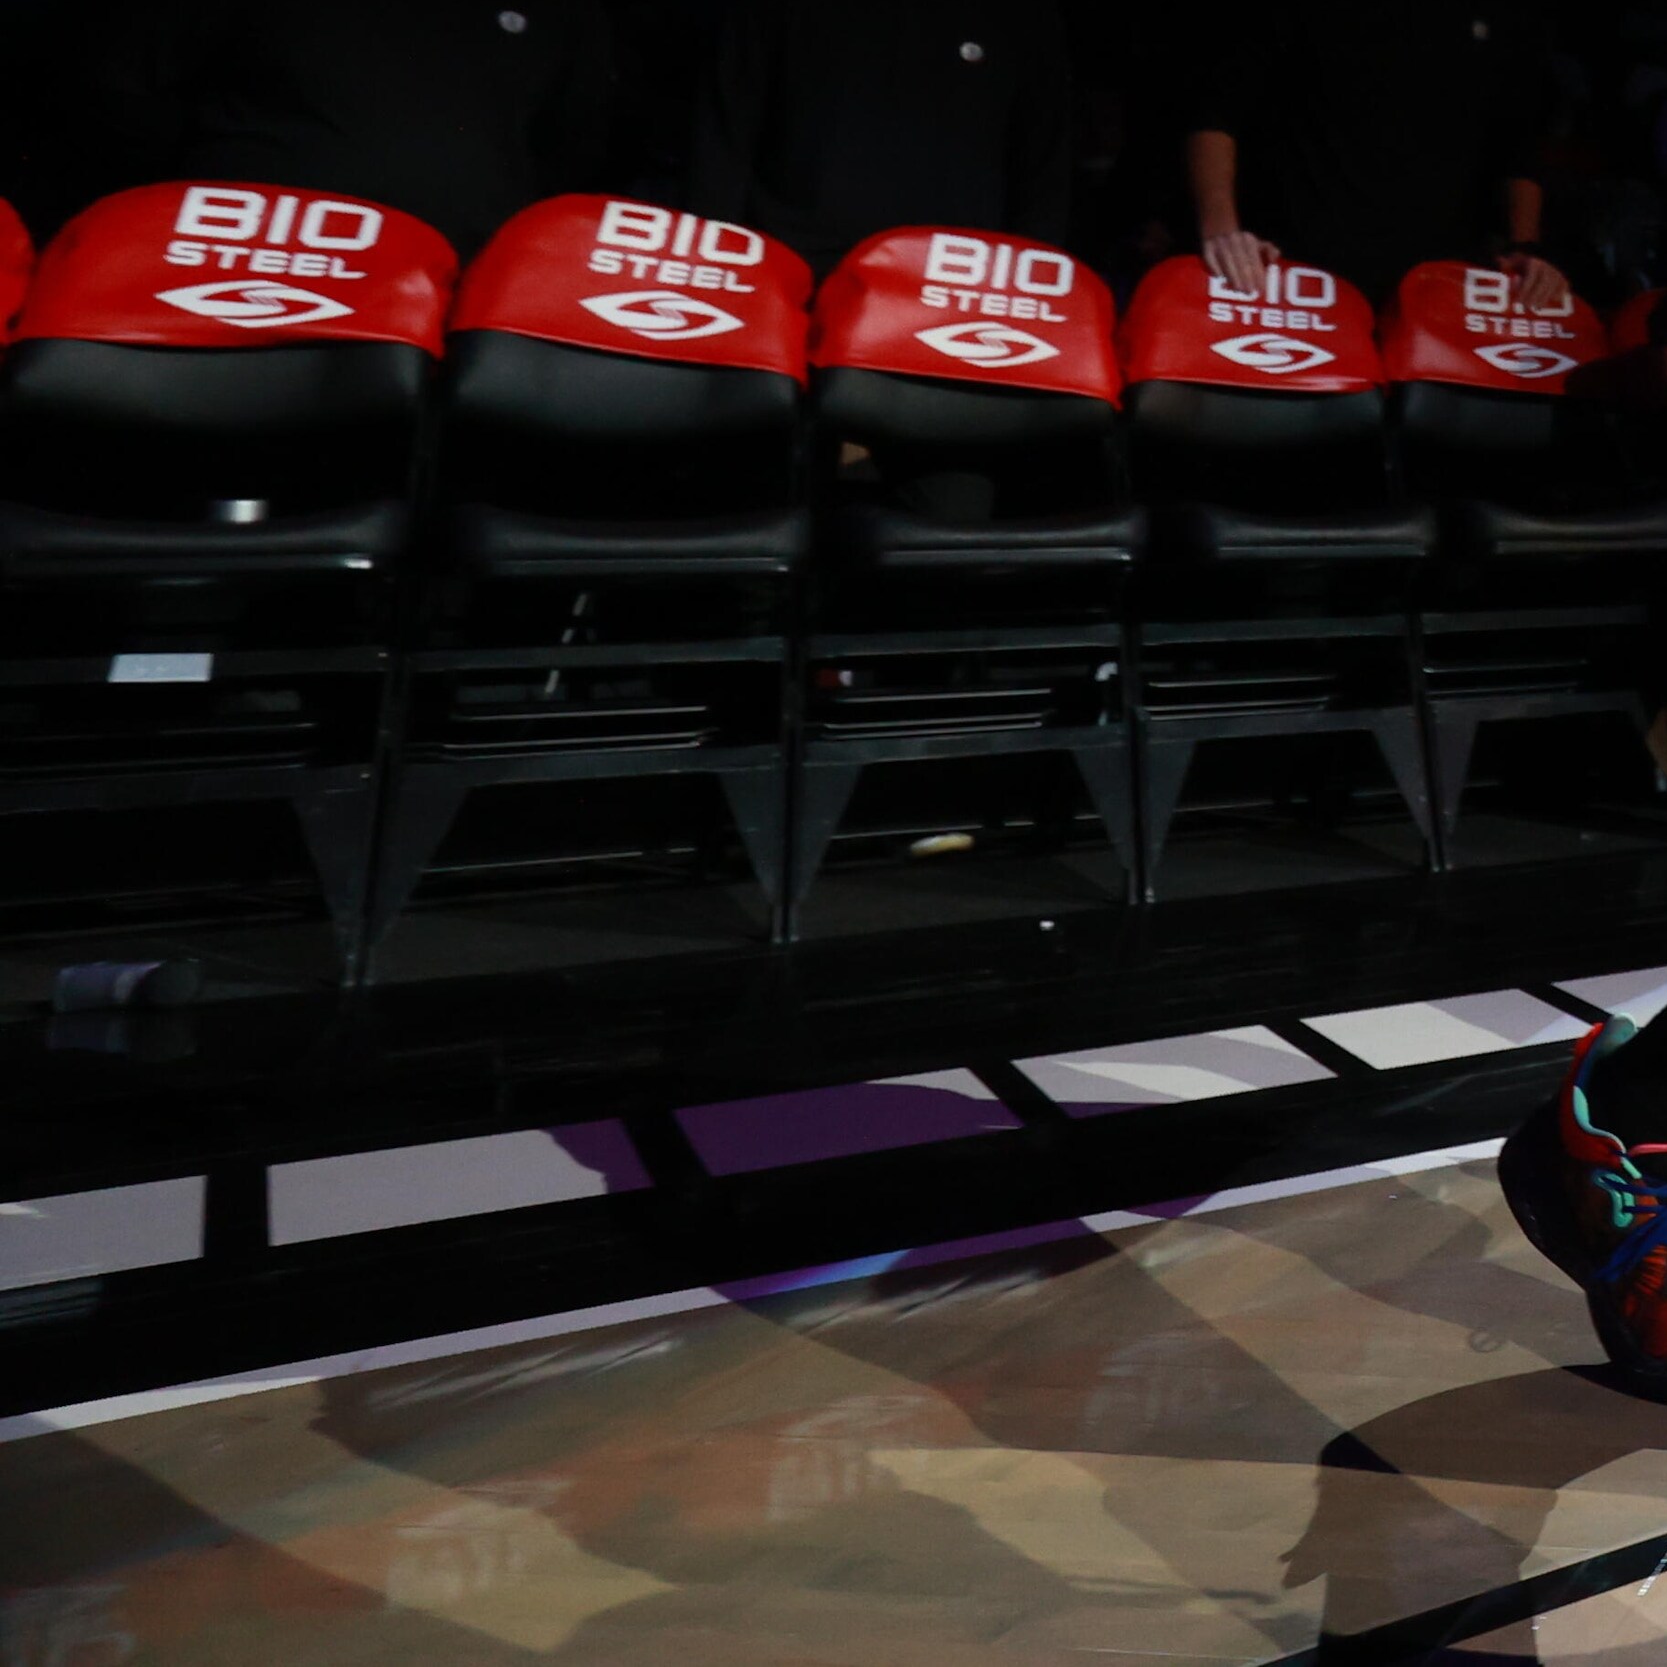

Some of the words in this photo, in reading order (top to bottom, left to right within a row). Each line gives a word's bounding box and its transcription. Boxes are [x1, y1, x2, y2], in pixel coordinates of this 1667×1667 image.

[173, 186, 385, 252] BIO
[595, 199, 766, 268] BIO
[163, 241, 368, 281] STEEL
[587, 248, 758, 294] STEEL
[923, 233, 1076, 297] BIO
[919, 283, 1068, 324] STEEL
[1208, 300, 1338, 333] STEEL
[1464, 313, 1577, 340] STEEL
